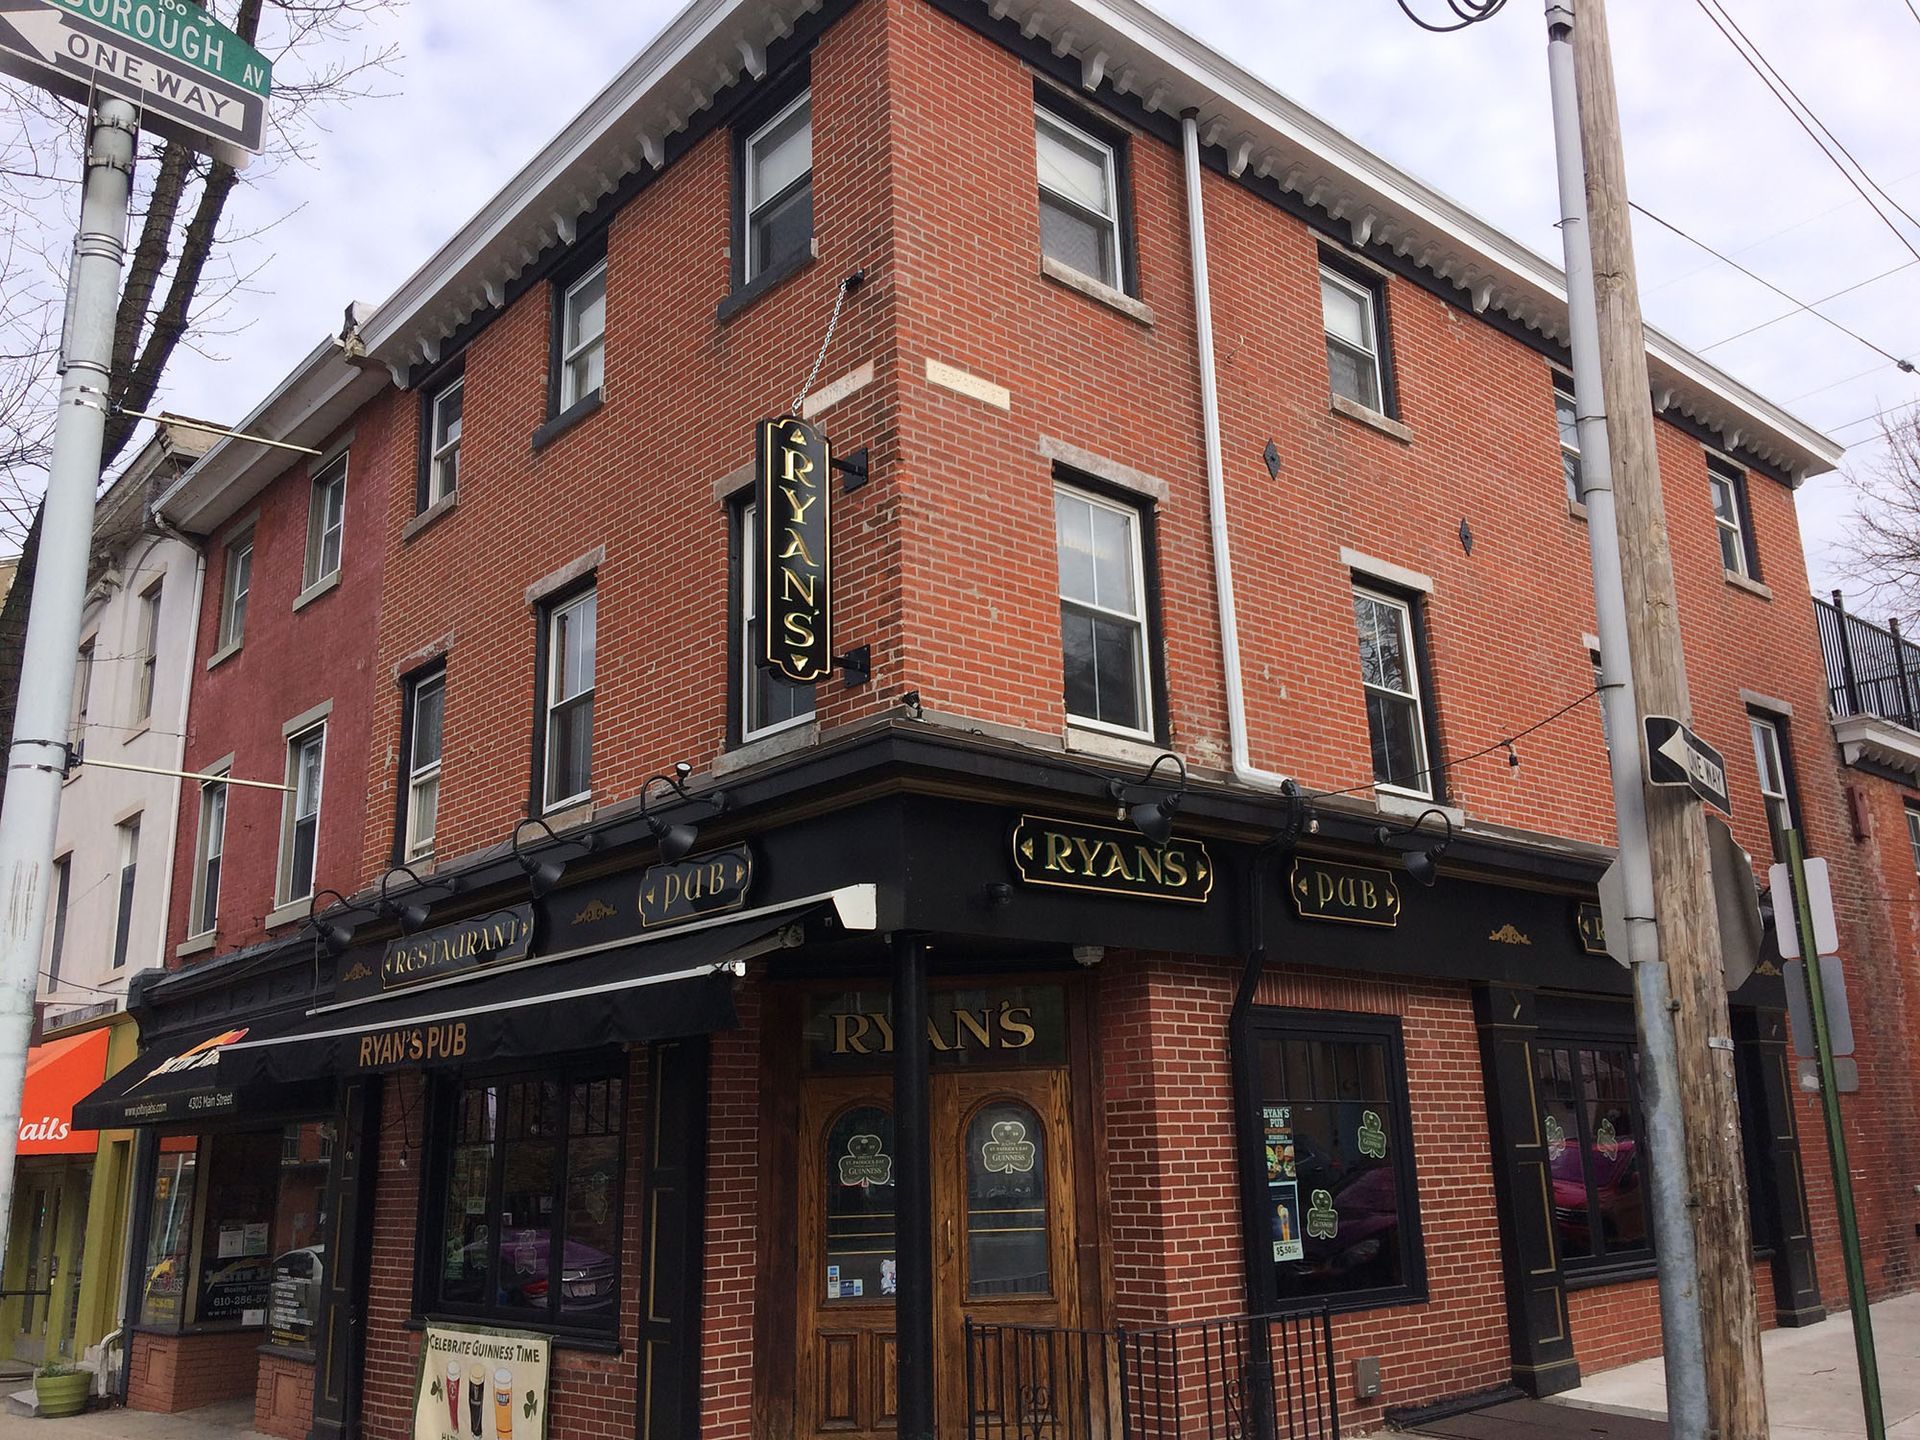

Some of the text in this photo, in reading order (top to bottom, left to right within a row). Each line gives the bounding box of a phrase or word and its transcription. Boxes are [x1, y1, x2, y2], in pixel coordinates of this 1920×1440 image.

[62, 0, 264, 89] OROUGH AV
[68, 33, 231, 118] ONE WAY
[779, 447, 820, 648] RYAN'S
[664, 862, 725, 913] PUB
[1316, 871, 1377, 910] PUB
[395, 918, 519, 974] RESTAURANT
[360, 1022, 467, 1067] RYAN'S PUB
[203, 1094, 216, 1108] Main
[216, 1092, 233, 1107] Street
[1263, 1107, 1290, 1119] RYAN'S
[18, 1116, 70, 1141] ails
[1270, 1119, 1284, 1128] PUB
[992, 1153, 1026, 1162] GUINNESS
[429, 1333, 541, 1363] CELEBRATE GUINNESS TIME
